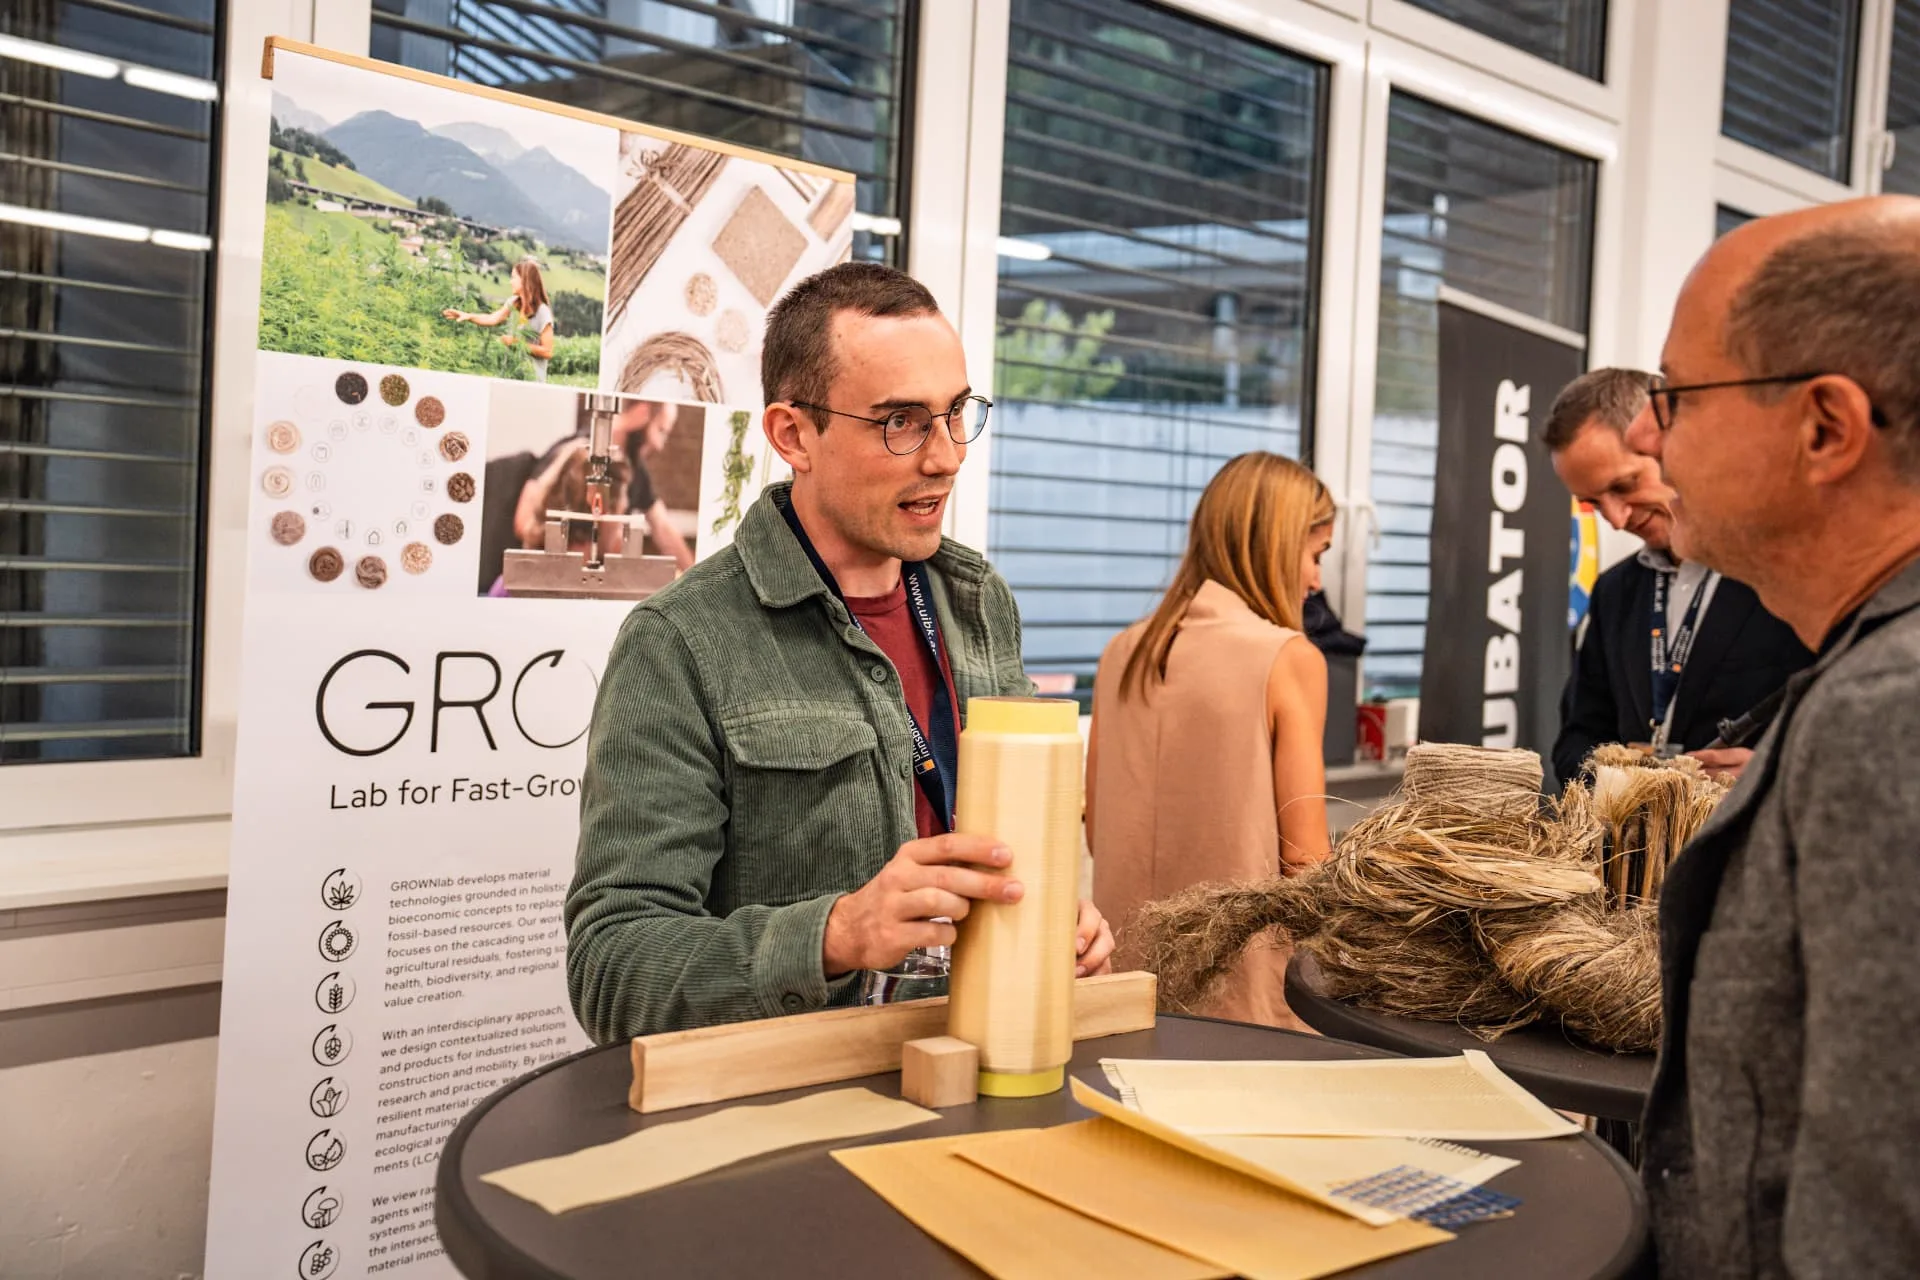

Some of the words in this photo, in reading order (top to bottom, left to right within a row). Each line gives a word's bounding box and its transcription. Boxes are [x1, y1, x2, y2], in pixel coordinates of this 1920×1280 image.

[1483, 379, 1530, 748] UBATOR
[330, 783, 387, 809] Lab
[398, 779, 441, 804] for
[452, 775, 581, 802] Fast-Gro
[391, 878, 453, 892] GROWNlab
[457, 873, 505, 886] develops
[509, 869, 550, 881] material
[390, 894, 462, 909] technologies
[465, 890, 516, 902] grounded
[519, 887, 528, 895] in
[531, 883, 566, 894] holistic
[388, 910, 460, 925] bioeconomic
[464, 905, 512, 918] concepts
[516, 903, 526, 912] to
[388, 926, 456, 941] fossil-based
[460, 920, 513, 933] resources.
[518, 917, 536, 927] Our
[540, 912, 562, 923] work
[387, 944, 431, 958] focuses
[434, 942, 448, 952] on
[451, 939, 468, 951] the
[472, 933, 525, 948] cascading
[528, 933, 545, 941] use
[548, 929, 559, 939] of
[385, 958, 448, 976] agricultural
[506, 946, 552, 959] fostering
[385, 978, 422, 991] health,
[427, 969, 492, 986] biodiversity,
[496, 966, 515, 977] and
[518, 960, 559, 974] regional
[384, 994, 413, 1007] value
[417, 988, 464, 1003] creation.
[382, 1029, 407, 1041] With
[411, 1028, 424, 1036] an
[427, 1014, 512, 1035] interdisciplinary
[516, 1006, 565, 1021] approach,
[381, 1047, 397, 1057] we
[400, 1042, 435, 1055] design
[440, 1028, 518, 1048] contextualized
[521, 1021, 566, 1035] solutions
[379, 1063, 401, 1074] and
[404, 1054, 454, 1072] products
[457, 1050, 472, 1061] for
[476, 1042, 527, 1057] industries
[530, 1037, 553, 1047] such
[556, 1036, 566, 1044] as
[379, 1072, 449, 1091] construction
[453, 1067, 472, 1078] and
[523, 1055, 536, 1066] By
[378, 1092, 426, 1107] research
[430, 1086, 449, 1097] and
[377, 1109, 422, 1124] resilient
[425, 1099, 469, 1115] material
[376, 1117, 457, 1141] manufacturing
[375, 1138, 432, 1158] ecological
[374, 1159, 409, 1174] ments
[372, 1196, 389, 1207] We
[392, 1190, 418, 1203] view
[370, 1208, 409, 1224] agents
[369, 1222, 416, 1242] systems
[368, 1253, 414, 1274] material
[369, 1246, 387, 1257] the
